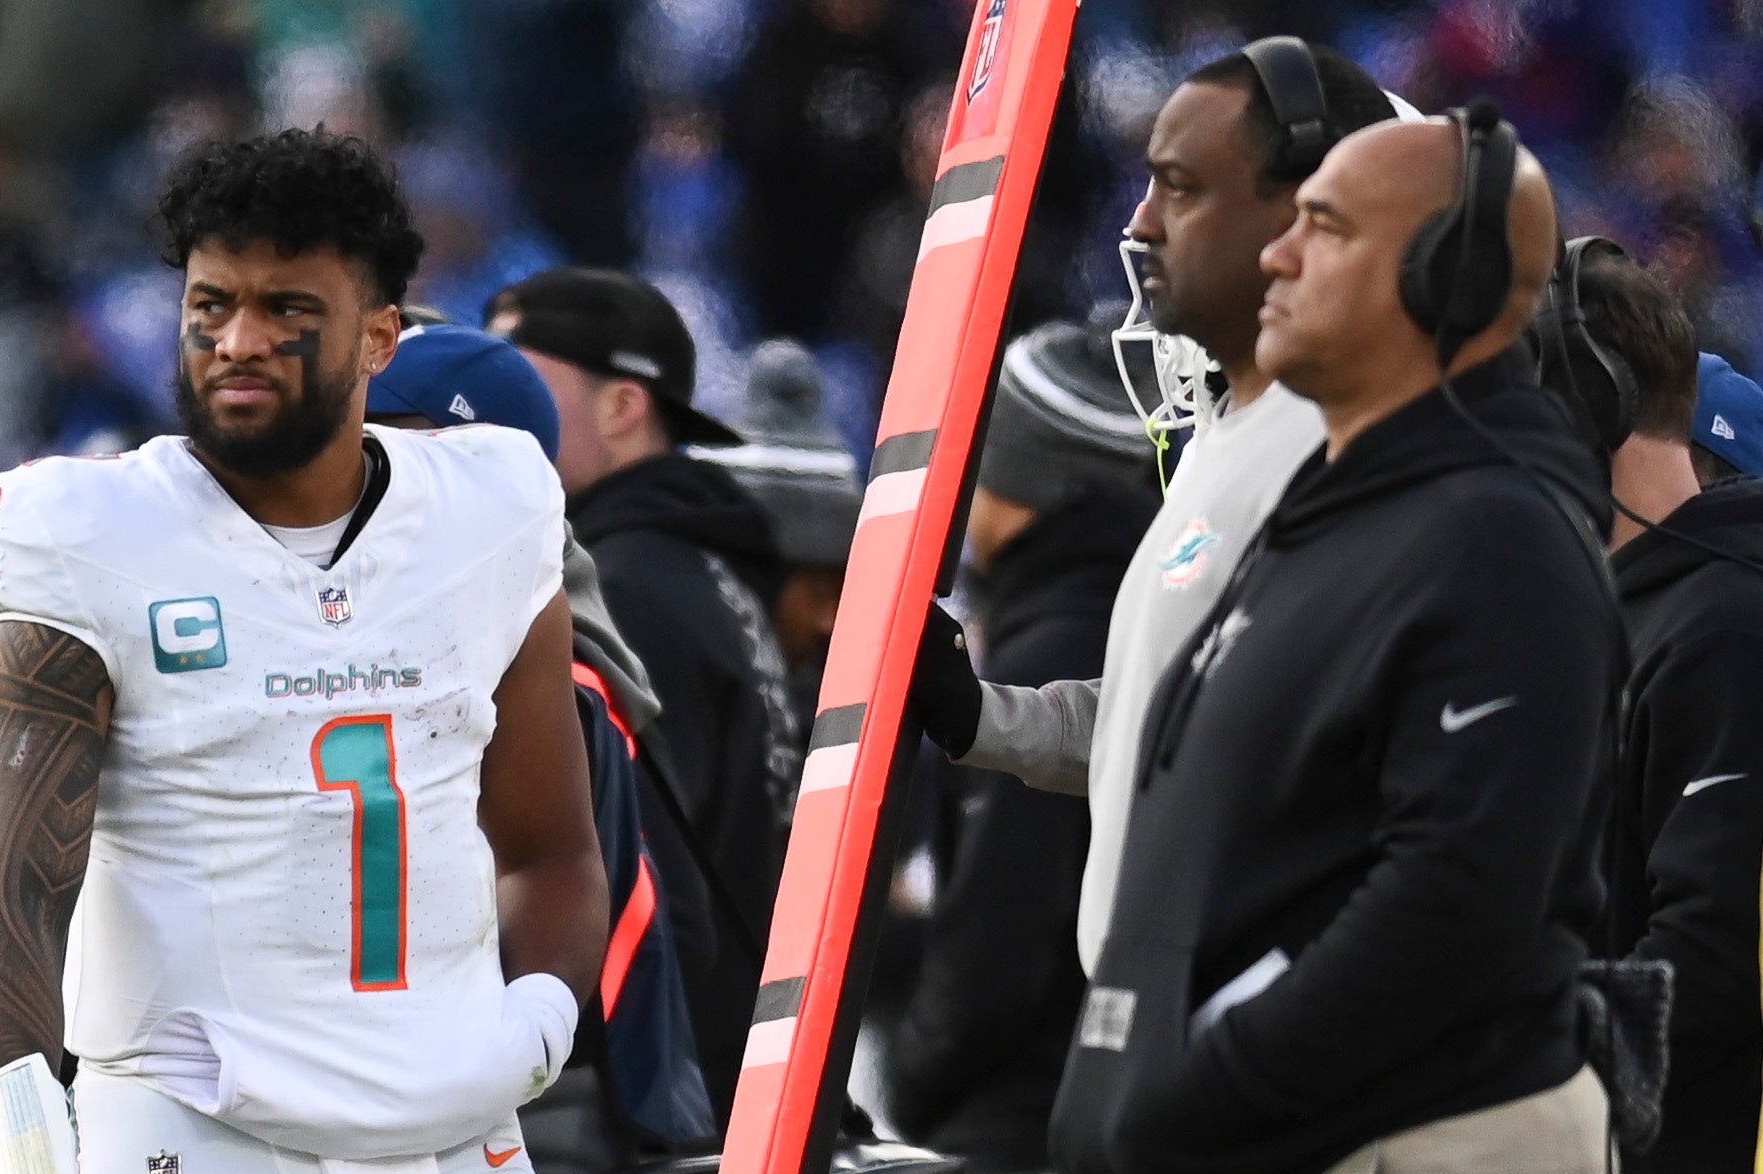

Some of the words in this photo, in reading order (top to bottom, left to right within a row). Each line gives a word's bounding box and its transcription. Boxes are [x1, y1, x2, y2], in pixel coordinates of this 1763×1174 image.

[155, 601, 220, 655] C
[324, 603, 348, 620] NFL
[264, 663, 423, 701] Dolphins
[310, 713, 408, 992] 1
